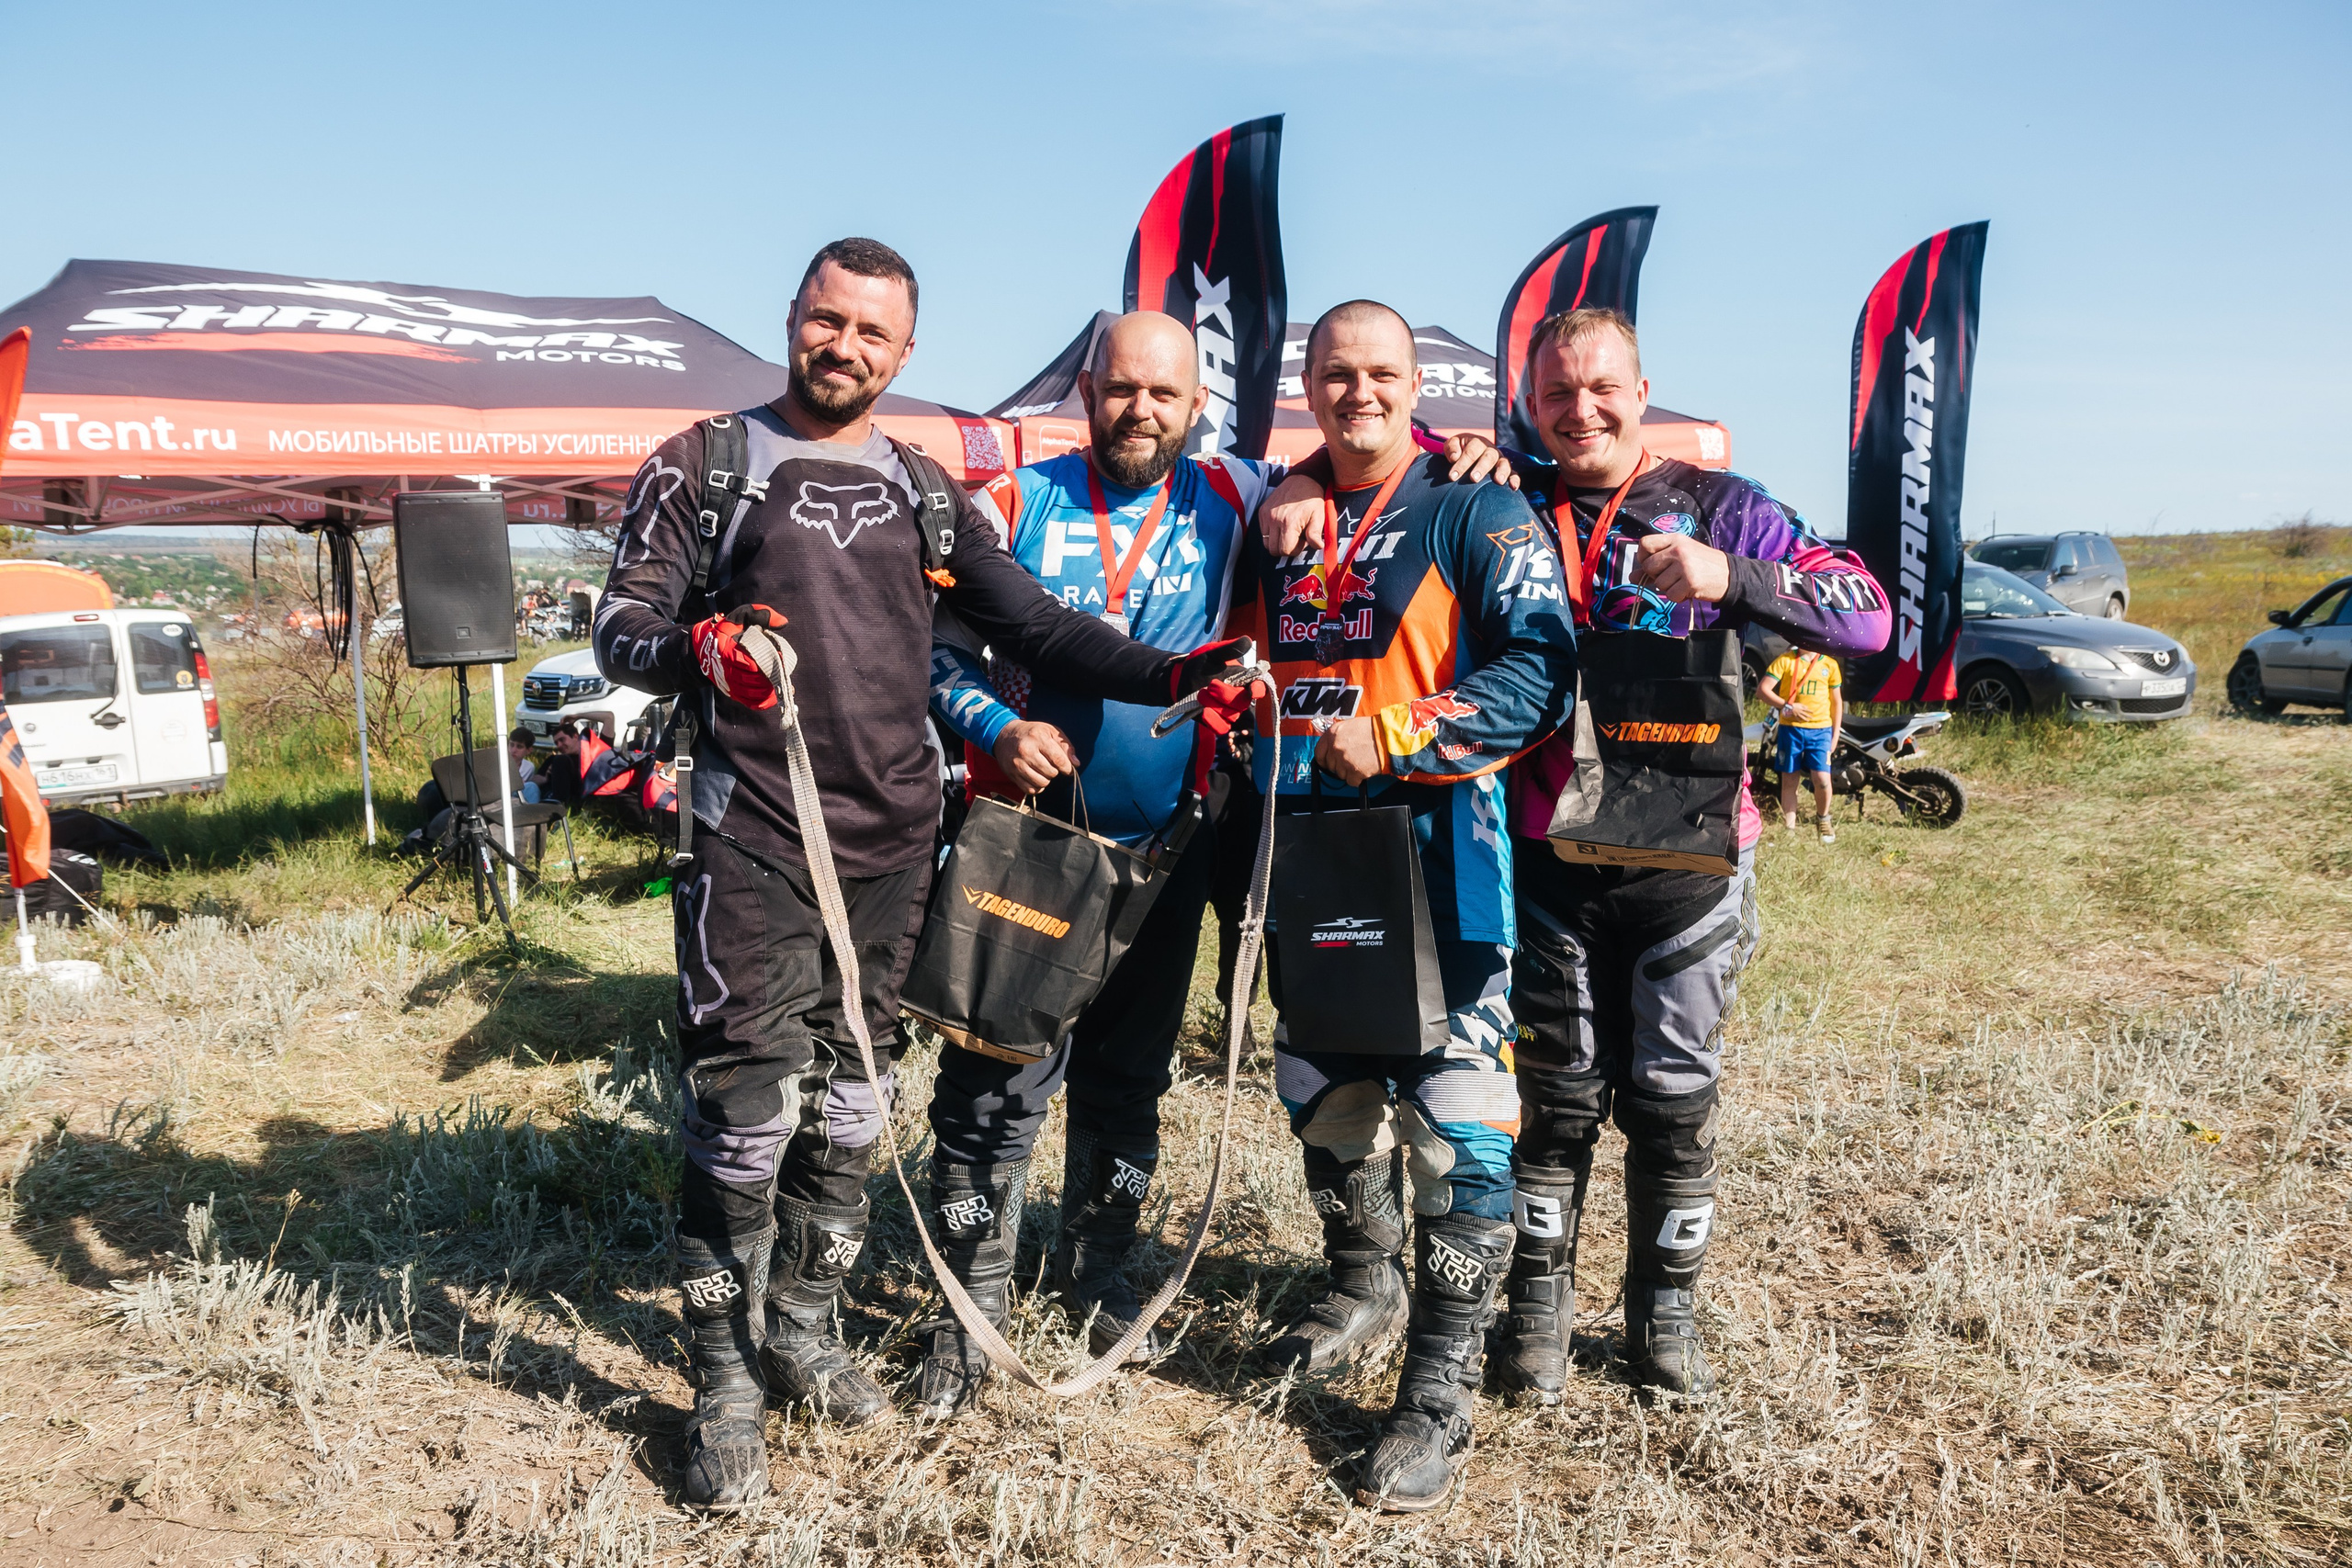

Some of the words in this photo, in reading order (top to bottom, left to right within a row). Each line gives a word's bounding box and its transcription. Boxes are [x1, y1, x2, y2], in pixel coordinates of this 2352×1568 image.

[66, 304, 684, 359] SHARMAX
[496, 349, 686, 372] MOTORS
[8, 412, 237, 451] aTent.ru
[268, 429, 443, 454] МОБИЛЬНЫЕ
[448, 432, 537, 455] ШАТРЫ
[544, 433, 676, 456] УСИЛЕННО
[1898, 325, 1935, 671] SHARMAX
[1063, 585, 1144, 608] RAE
[1340, 607, 1373, 641] ull
[610, 634, 669, 671] FOX
[1282, 682, 1360, 717] KTM
[1618, 721, 1721, 744] TAGENDURO
[976, 891, 1070, 939] TAGENDURO
[1310, 930, 1385, 942] SHARMAX
[1656, 1203, 1714, 1250] G
